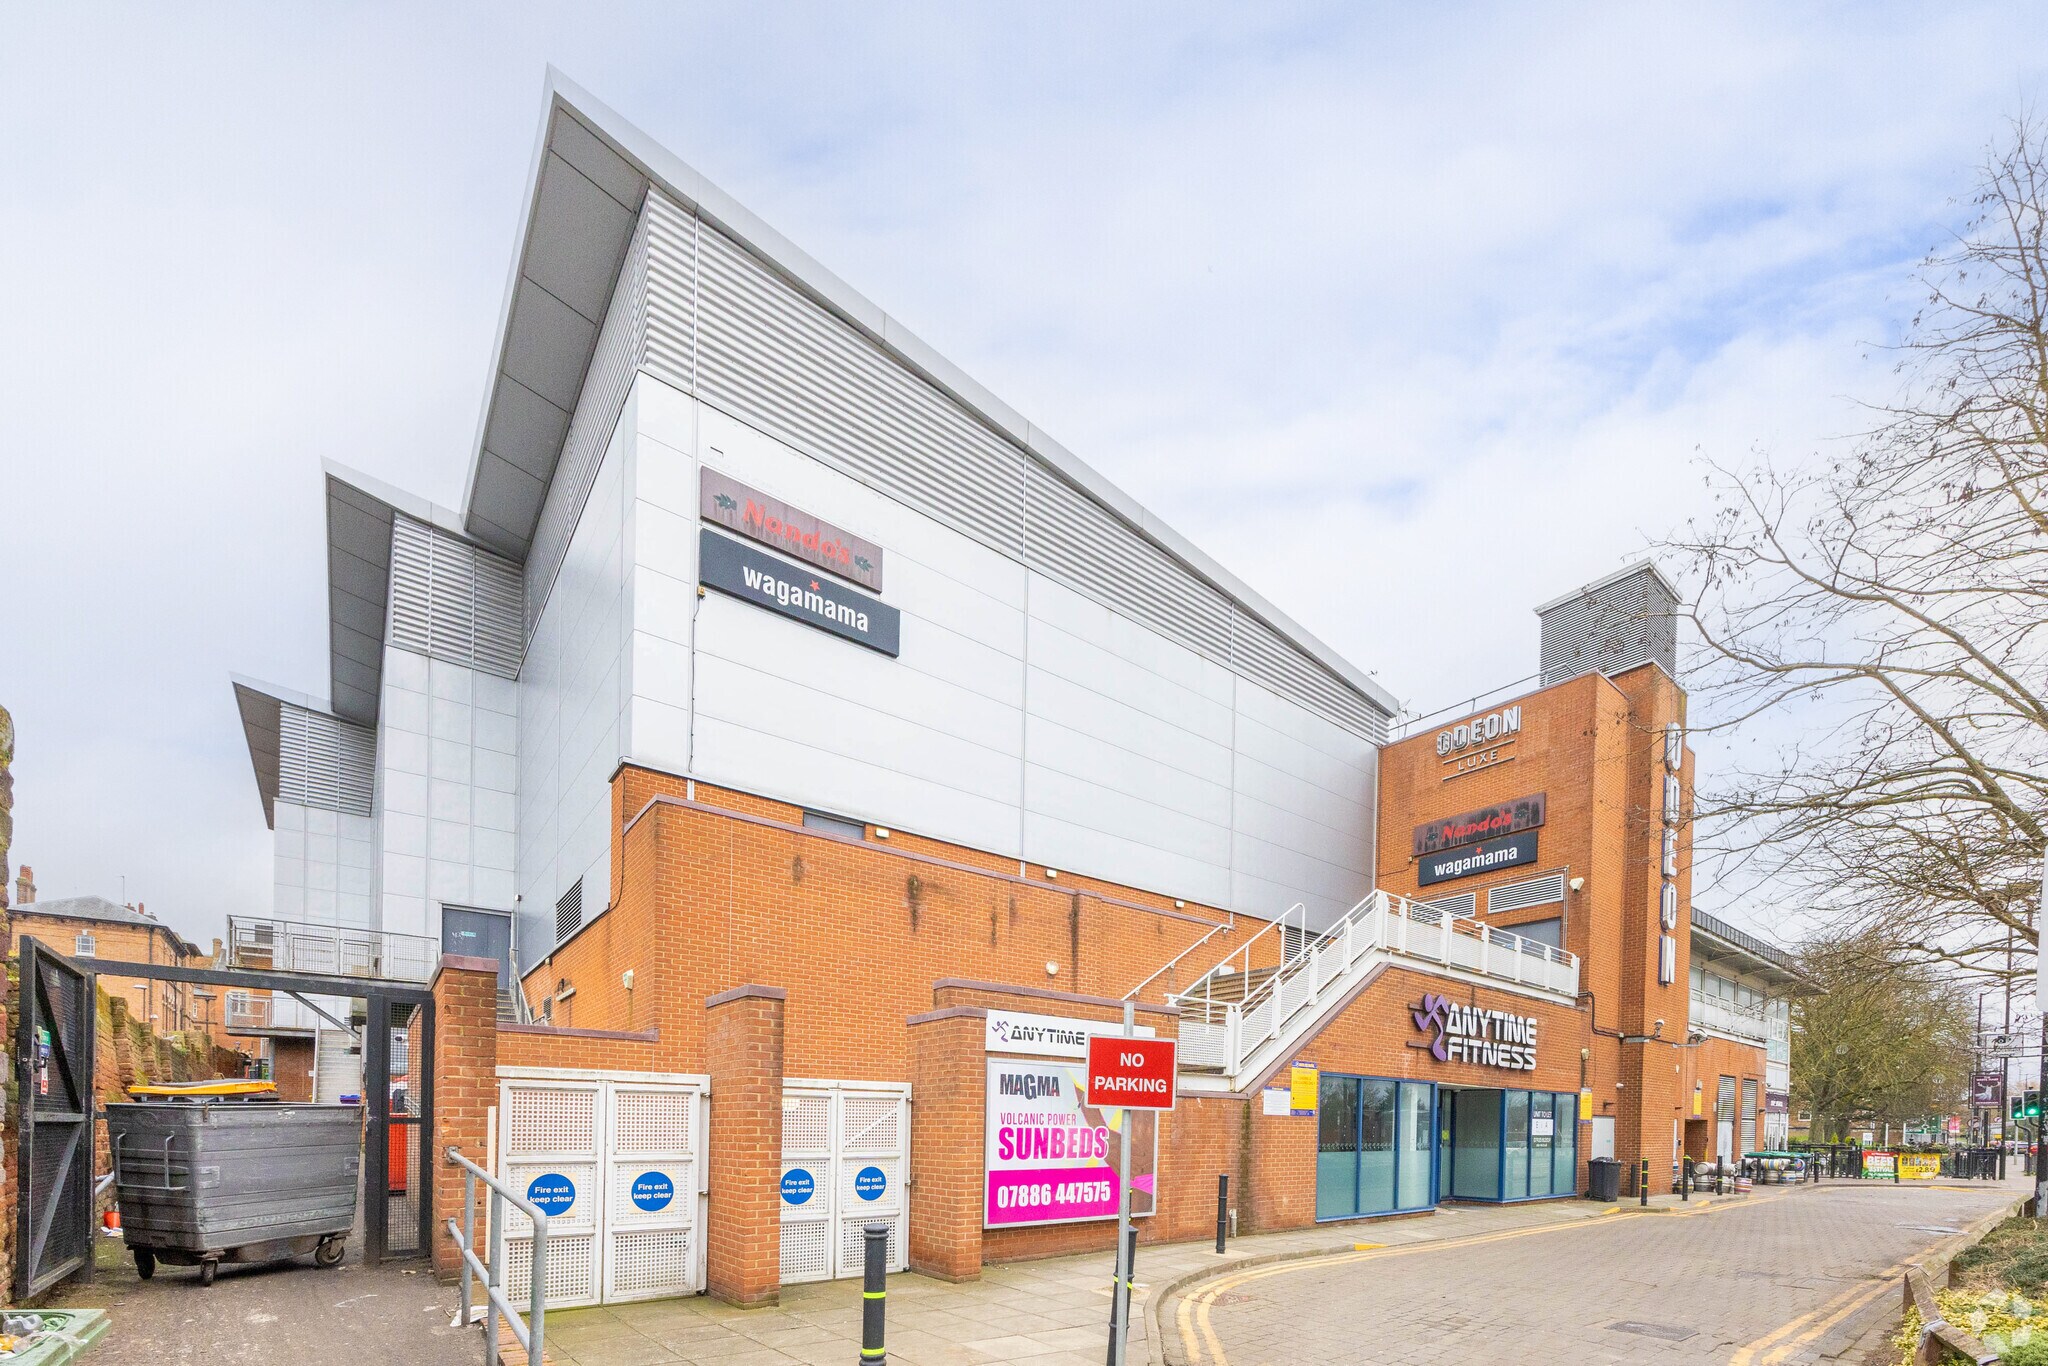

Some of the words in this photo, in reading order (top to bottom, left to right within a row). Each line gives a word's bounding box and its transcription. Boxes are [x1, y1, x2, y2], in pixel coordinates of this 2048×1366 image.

[742, 497, 851, 566] Nando's
[742, 566, 869, 632] wagamama
[1436, 705, 1522, 757] ODEON
[1457, 750, 1498, 771] LUXE
[1441, 808, 1513, 841] Nando's
[1434, 846, 1518, 876] wagamama
[1010, 1025, 1085, 1046] ANYTIME
[1446, 1002, 1537, 1046] ANYTIME
[1119, 1052, 1145, 1068] NO
[1447, 1036, 1537, 1070] FITNESS
[1000, 1073, 1061, 1101] MAGMA
[1094, 1075, 1168, 1093] PARKING
[1000, 1112, 1045, 1126] VOLCANIC
[1047, 1113, 1077, 1126] POWER
[998, 1127, 1109, 1161] SUNBEDS
[1867, 1156, 1894, 1166] BEER
[534, 1186, 552, 1194] Fire
[553, 1186, 569, 1194] exit
[633, 1192, 652, 1200] keep
[653, 1191, 672, 1199] clear
[638, 1183, 653, 1191] Fire
[997, 1183, 1051, 1209] 07886
[1055, 1181, 1111, 1204] 447575
[529, 1196, 551, 1204] keep
[552, 1195, 573, 1203] clear
